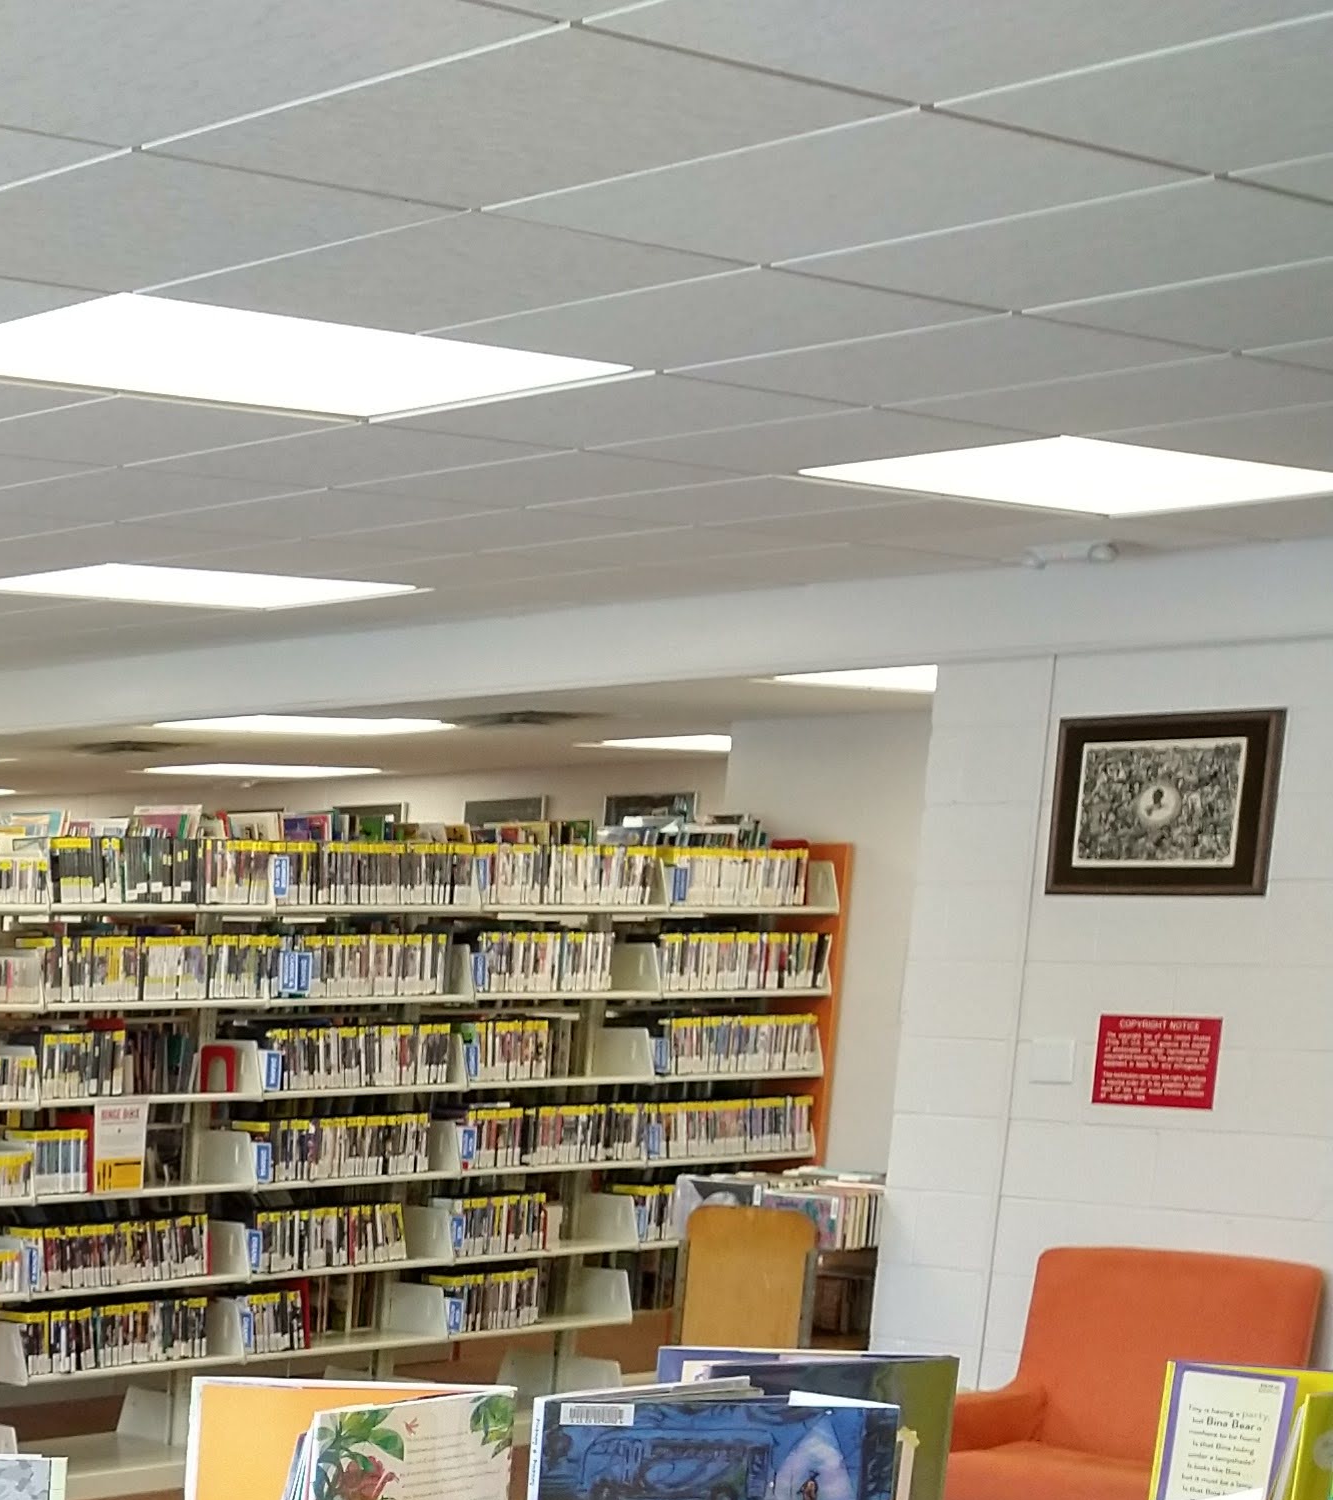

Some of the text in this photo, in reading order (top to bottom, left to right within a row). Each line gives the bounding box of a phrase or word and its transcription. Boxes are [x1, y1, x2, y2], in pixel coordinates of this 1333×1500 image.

[1119, 1018, 1200, 1031] COPYRIGHT NOTICE
[1206, 1416, 1255, 1432] Bina Bear
